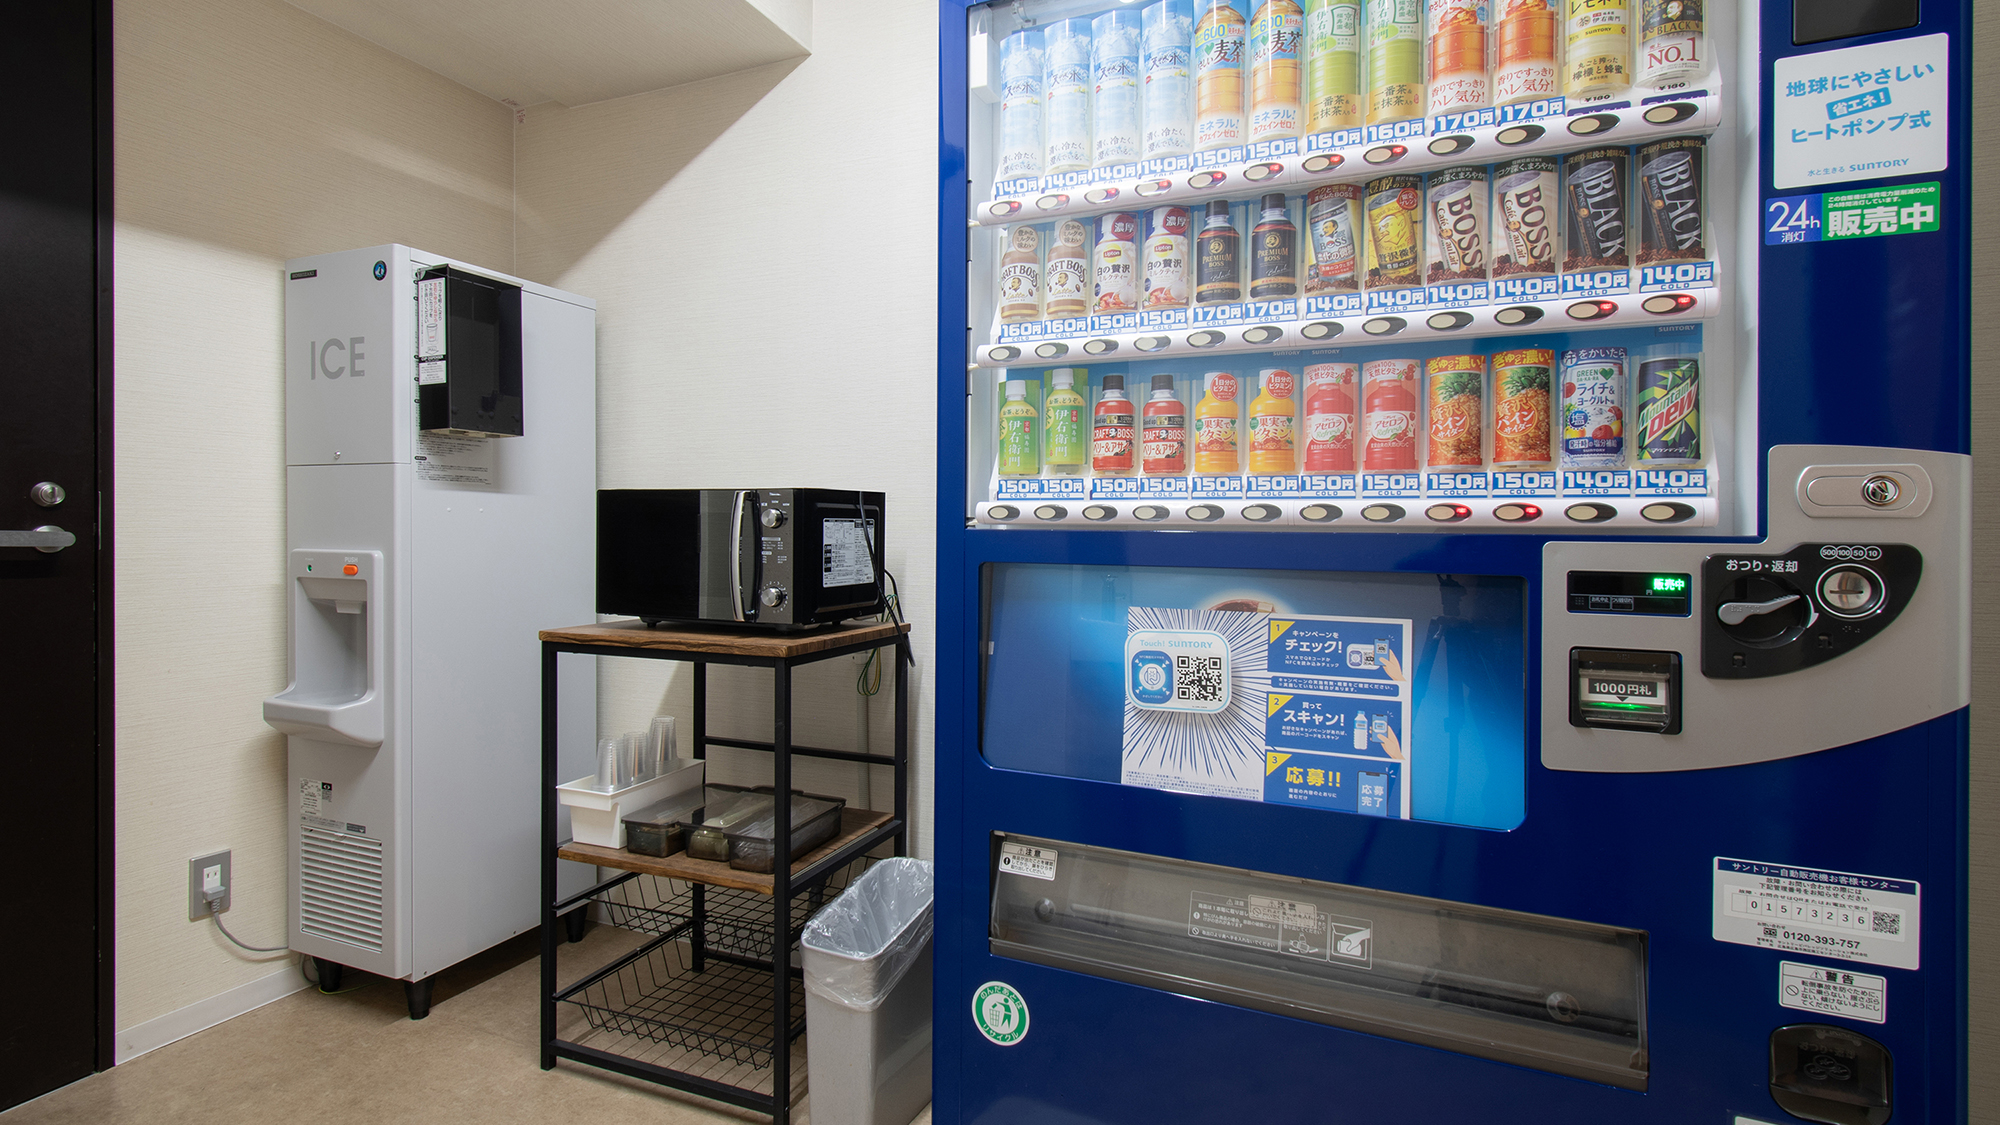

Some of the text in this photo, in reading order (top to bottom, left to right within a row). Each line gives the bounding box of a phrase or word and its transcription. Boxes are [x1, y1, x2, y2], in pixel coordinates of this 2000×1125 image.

[1585, 27, 1611, 35] SUNTORY
[1656, 21, 1691, 35] BLACK
[1271, 30, 1302, 54] 麦茶
[1214, 39, 1246, 65] 麦茶
[1647, 37, 1700, 69] NO.1
[1577, 57, 1618, 70] 丸ごと搾った
[1497, 66, 1554, 86] 香りですっきり
[1572, 65, 1623, 81] 檸檬と蜂蜜
[1785, 63, 1935, 98] 地球にやさしい
[1431, 79, 1486, 98] 香りですっきり
[1496, 78, 1554, 100] ハレ気分!
[1430, 90, 1485, 111] ハレ気分!
[1832, 90, 1886, 116] 省エネ!
[1254, 109, 1296, 124] ミネラル!
[1505, 100, 1563, 121] 170円
[1199, 118, 1239, 133] ミネラル!
[1437, 109, 1495, 131] 170円
[1791, 109, 1932, 143] ヒートポンプ式
[1368, 121, 1423, 141] 160円
[1309, 131, 1361, 149] 160円
[1250, 141, 1298, 158] 150円
[1195, 149, 1243, 166] 150円
[1142, 157, 1189, 174] 140円
[1807, 157, 1910, 177] 水と生きる SUNTORY
[1046, 173, 1088, 188] 140円
[1093, 166, 1136, 182] 140円
[996, 180, 1037, 195] 140円
[1649, 178, 1661, 198] BOSS
[1575, 187, 1587, 207] BOSS
[1656, 161, 1702, 250] BLACK
[1165, 215, 1186, 227] 濃厚
[1515, 184, 1552, 261] BOSS
[1582, 171, 1625, 259] BLACK
[1768, 198, 1821, 233] 24h
[1827, 202, 1934, 238] 販売中
[1114, 222, 1134, 232] 濃厚
[1447, 192, 1483, 267] BOSS
[1781, 230, 1805, 243] 消灯
[1202, 253, 1232, 264] PREMIUM
[1257, 247, 1289, 259] PREMIUM
[1147, 258, 1182, 272] 白の贅沢
[1564, 272, 1628, 291] 140円
[1643, 265, 1711, 284] 140円
[1429, 284, 1487, 302] 140円
[1496, 278, 1557, 296] 140円
[1308, 296, 1360, 312] 140円
[1370, 289, 1424, 307] 140円
[1444, 300, 1469, 308] COLD
[1195, 305, 1242, 320] 170円
[1247, 301, 1295, 316] 170円
[1092, 315, 1136, 330] 150円
[1141, 311, 1186, 326] 150円
[1002, 323, 1041, 338] 160円
[1045, 319, 1087, 335] 160円
[310, 336, 365, 381] ICE
[1270, 374, 1292, 382] 1日分の
[1576, 369, 1599, 377] GREEN
[1213, 384, 1236, 392] ビタミン!
[1214, 377, 1236, 386] 1日分の
[1269, 381, 1293, 390] ビタミン!
[1577, 382, 1615, 396] ライチ&
[1638, 382, 1691, 427] Mountain
[1204, 418, 1230, 430] 果実で
[1259, 416, 1287, 428] 果実で
[1314, 420, 1342, 432] アセロラ
[1375, 418, 1404, 430] アセロラ
[1430, 413, 1467, 434] パイン
[1496, 409, 1534, 430] パイン
[1571, 412, 1585, 425] 塩
[1055, 409, 1069, 457] 伊右衛門
[1117, 428, 1134, 438] BOSS
[1168, 429, 1185, 440] BOSS
[1198, 429, 1235, 441] ビタミン!
[1253, 427, 1291, 440] ビタミン!
[1436, 426, 1464, 439] サイダー
[1503, 423, 1533, 435] サイダー
[1008, 420, 1022, 467] 伊右衛門
[1000, 480, 1038, 492] 150円
[1041, 480, 1083, 492] 150円
[1094, 479, 1137, 492] 150円
[1142, 479, 1187, 492] 150円
[1194, 478, 1240, 491] 150円
[1249, 477, 1297, 491] 150円
[1303, 476, 1353, 490] 150円
[1365, 475, 1418, 490] 150円
[1429, 474, 1485, 490] 150円
[1495, 473, 1554, 489] 150円
[1566, 472, 1629, 487] 140円
[1638, 471, 1705, 487] 140円
[1868, 549, 1878, 557] 10
[1725, 559, 1798, 573] おつり・返却
[1653, 577, 1685, 591] 販売中
[1292, 630, 1339, 639] キャンペーンを
[1140, 639, 1213, 649] Touch! SUNTORY
[1285, 638, 1342, 653] チェック!
[1594, 682, 1652, 695] 1000円札
[1274, 697, 1280, 706] 2
[1302, 701, 1322, 710] 買って
[1283, 709, 1344, 726] スキャン!
[1272, 755, 1278, 764] 3
[1285, 766, 1341, 787] 応募!!
[1361, 784, 1384, 796] 応募
[1361, 796, 1383, 808] 完了
[1732, 862, 1900, 890] サントリー自動販売機お客様センター
[1783, 930, 1860, 949] 0120-393-757
[1825, 971, 1854, 985] 警告
[980, 985, 1023, 1010] のんだあとは
[1801, 999, 1841, 1011] てください。
[983, 1023, 1019, 1042] リサイクル
